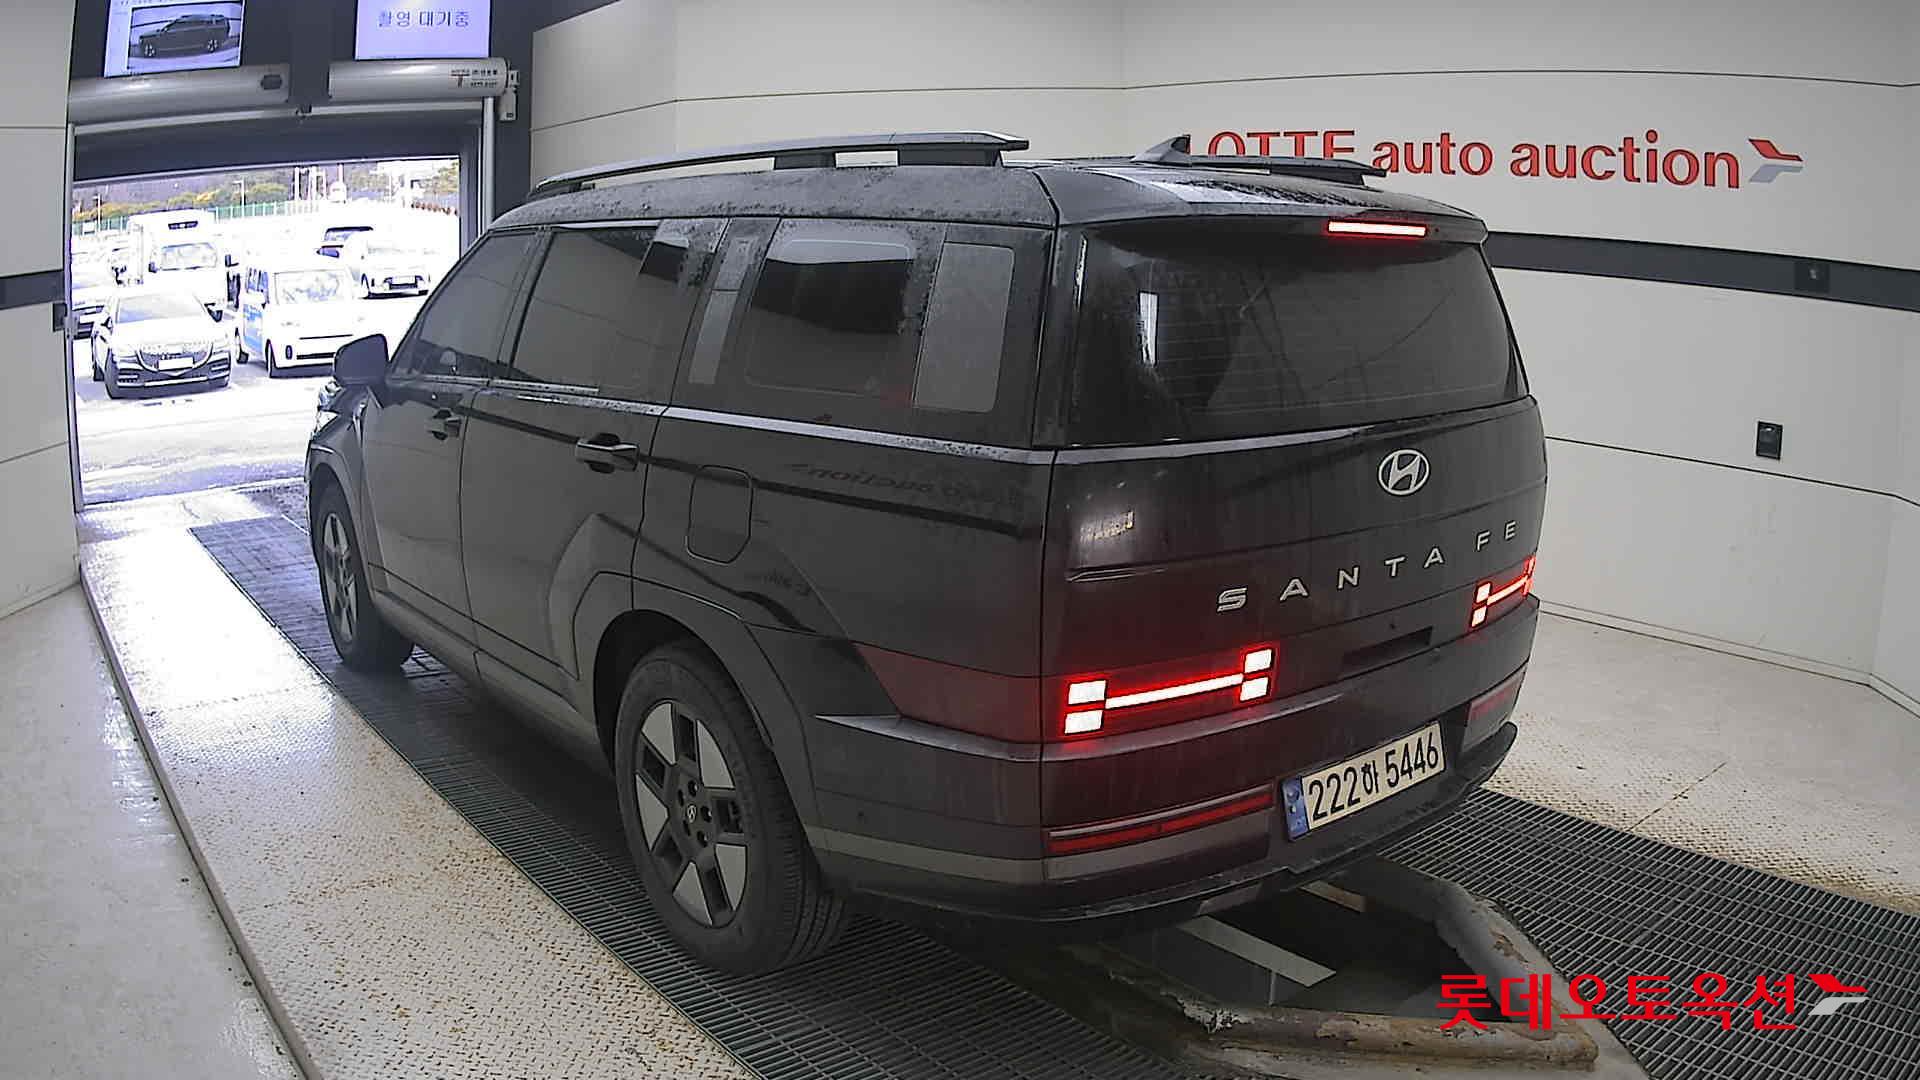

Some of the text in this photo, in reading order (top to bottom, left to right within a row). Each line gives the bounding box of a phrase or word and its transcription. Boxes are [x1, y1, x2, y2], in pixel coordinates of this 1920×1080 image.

[1187, 129, 1741, 189] OTTE auto auction
[1216, 520, 1517, 613] SANTA FE
[1307, 731, 1440, 822] 222하 5446
